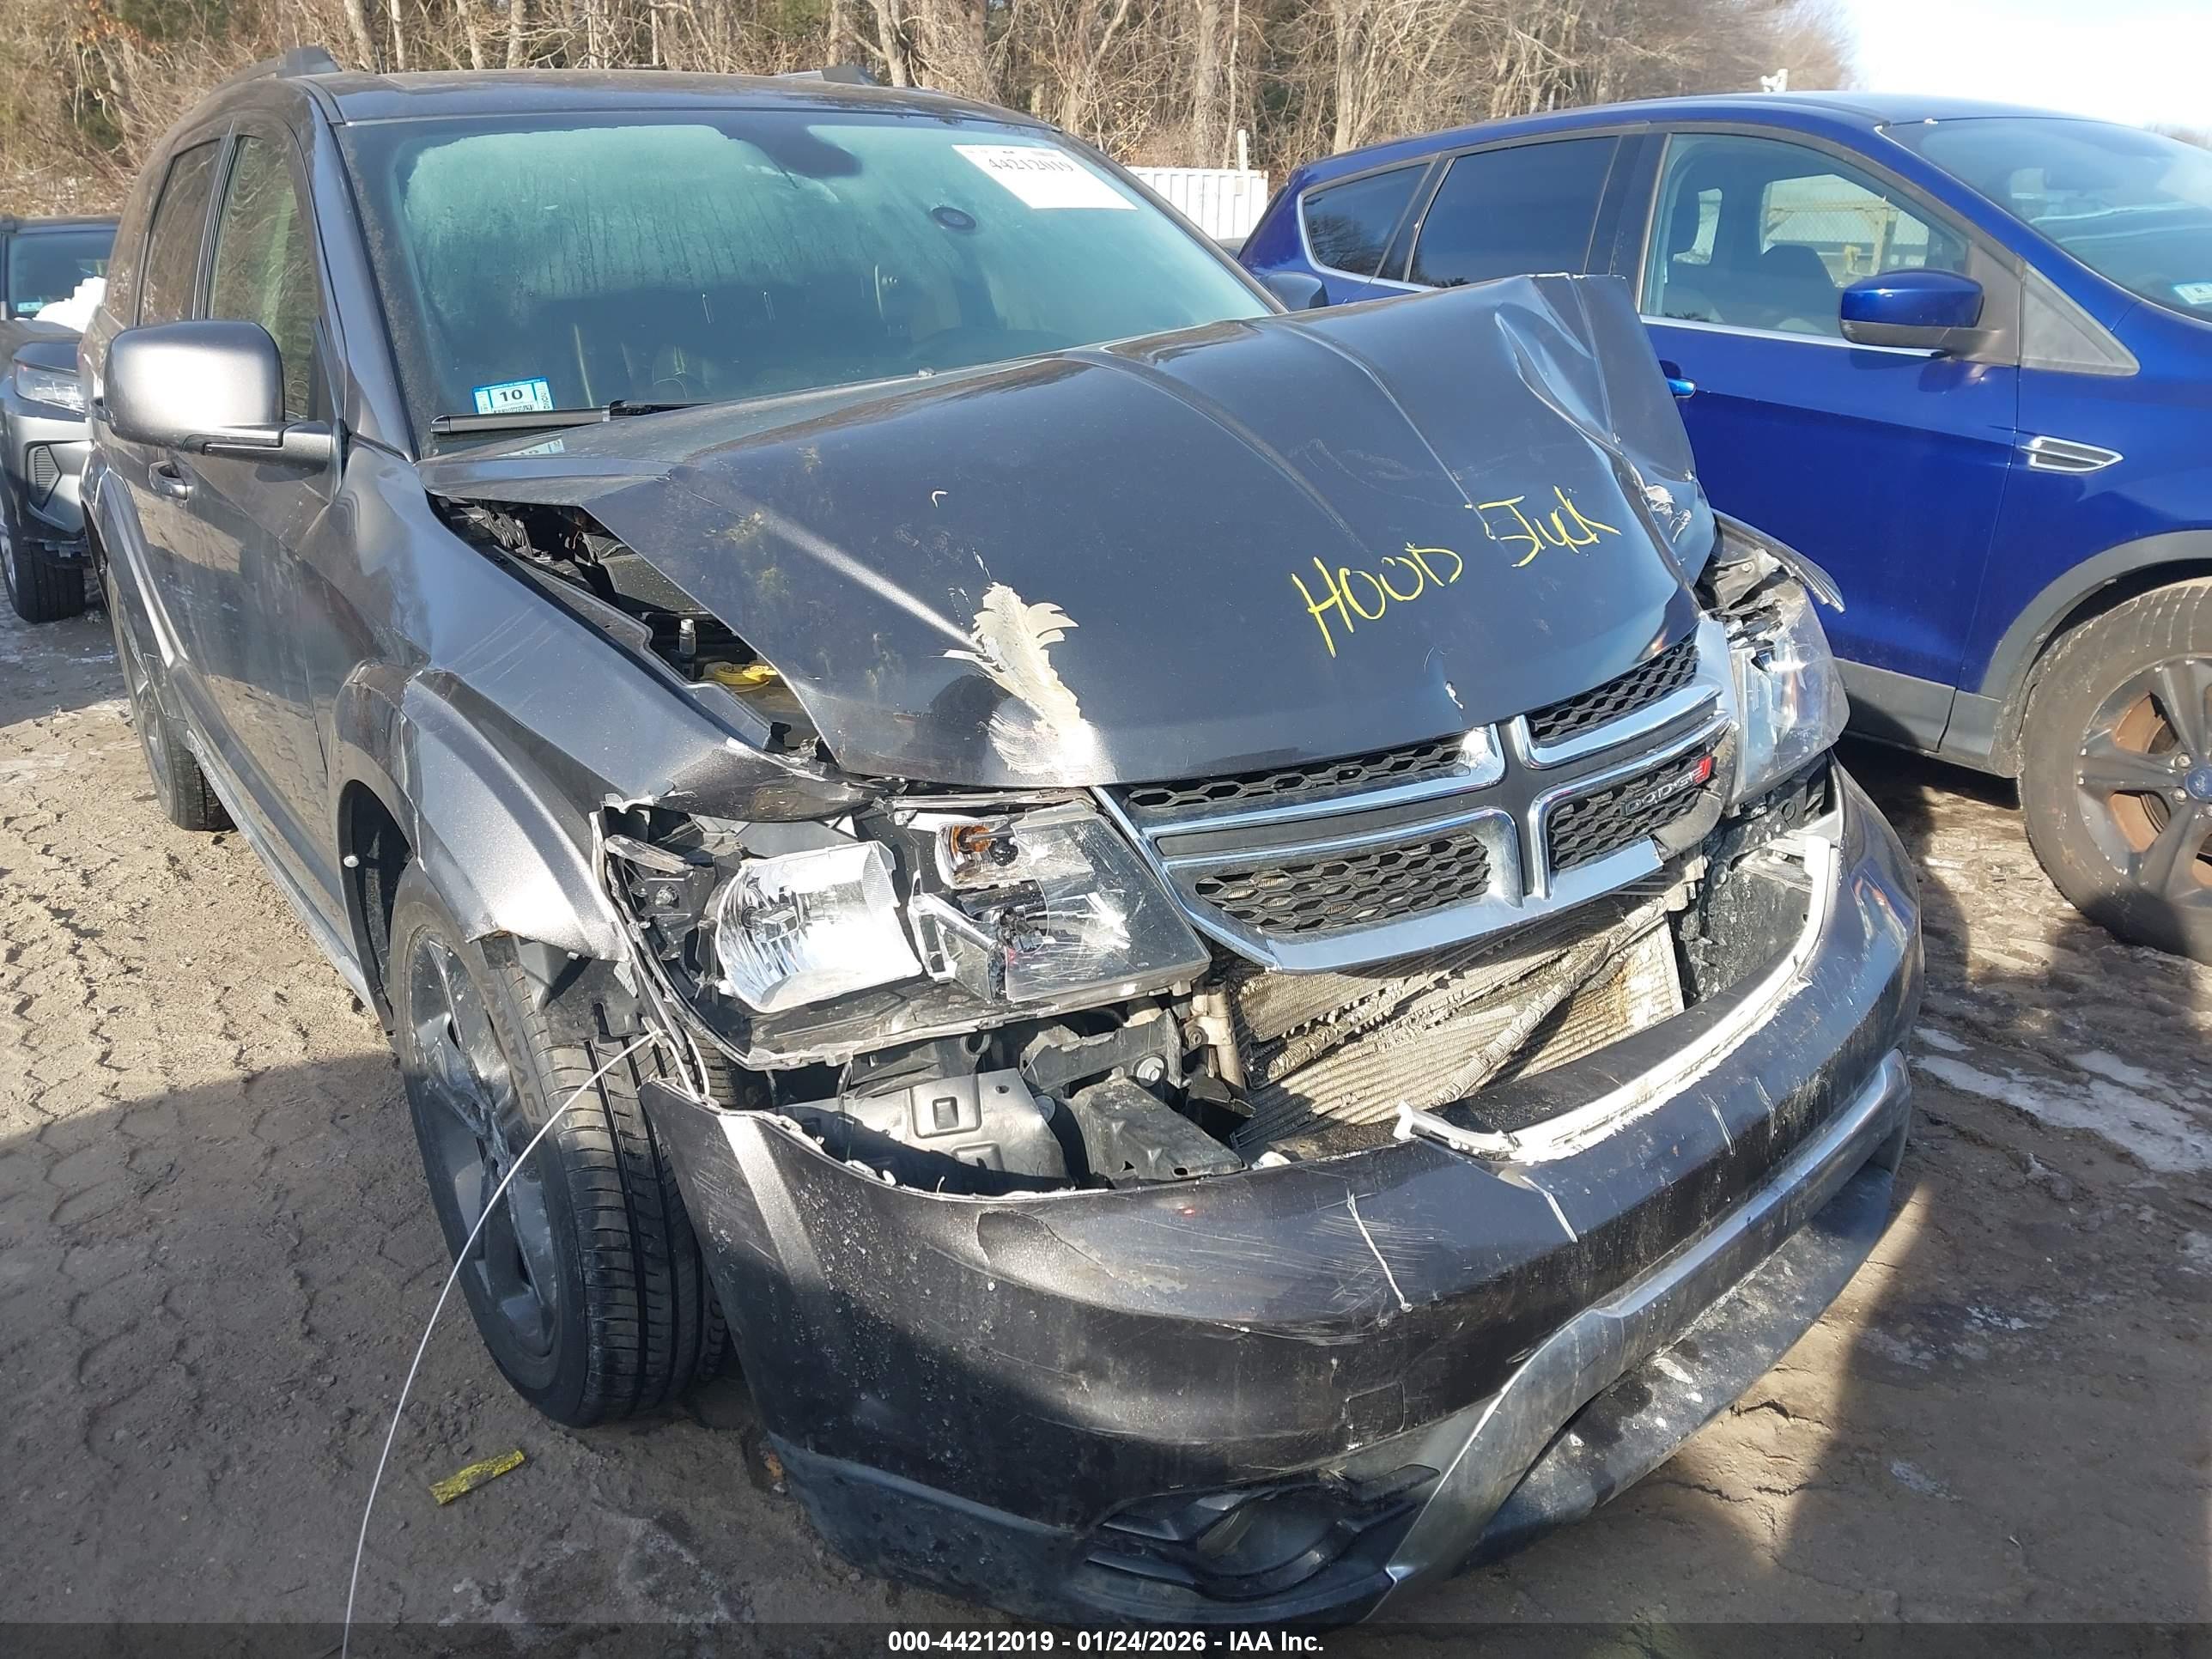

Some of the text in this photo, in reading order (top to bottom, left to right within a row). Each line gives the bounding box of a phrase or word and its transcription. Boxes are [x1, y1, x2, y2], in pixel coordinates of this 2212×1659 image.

[499, 389, 524, 402] 10
[1291, 541, 1464, 659] HOOD
[1627, 769, 1704, 812] DODGE
